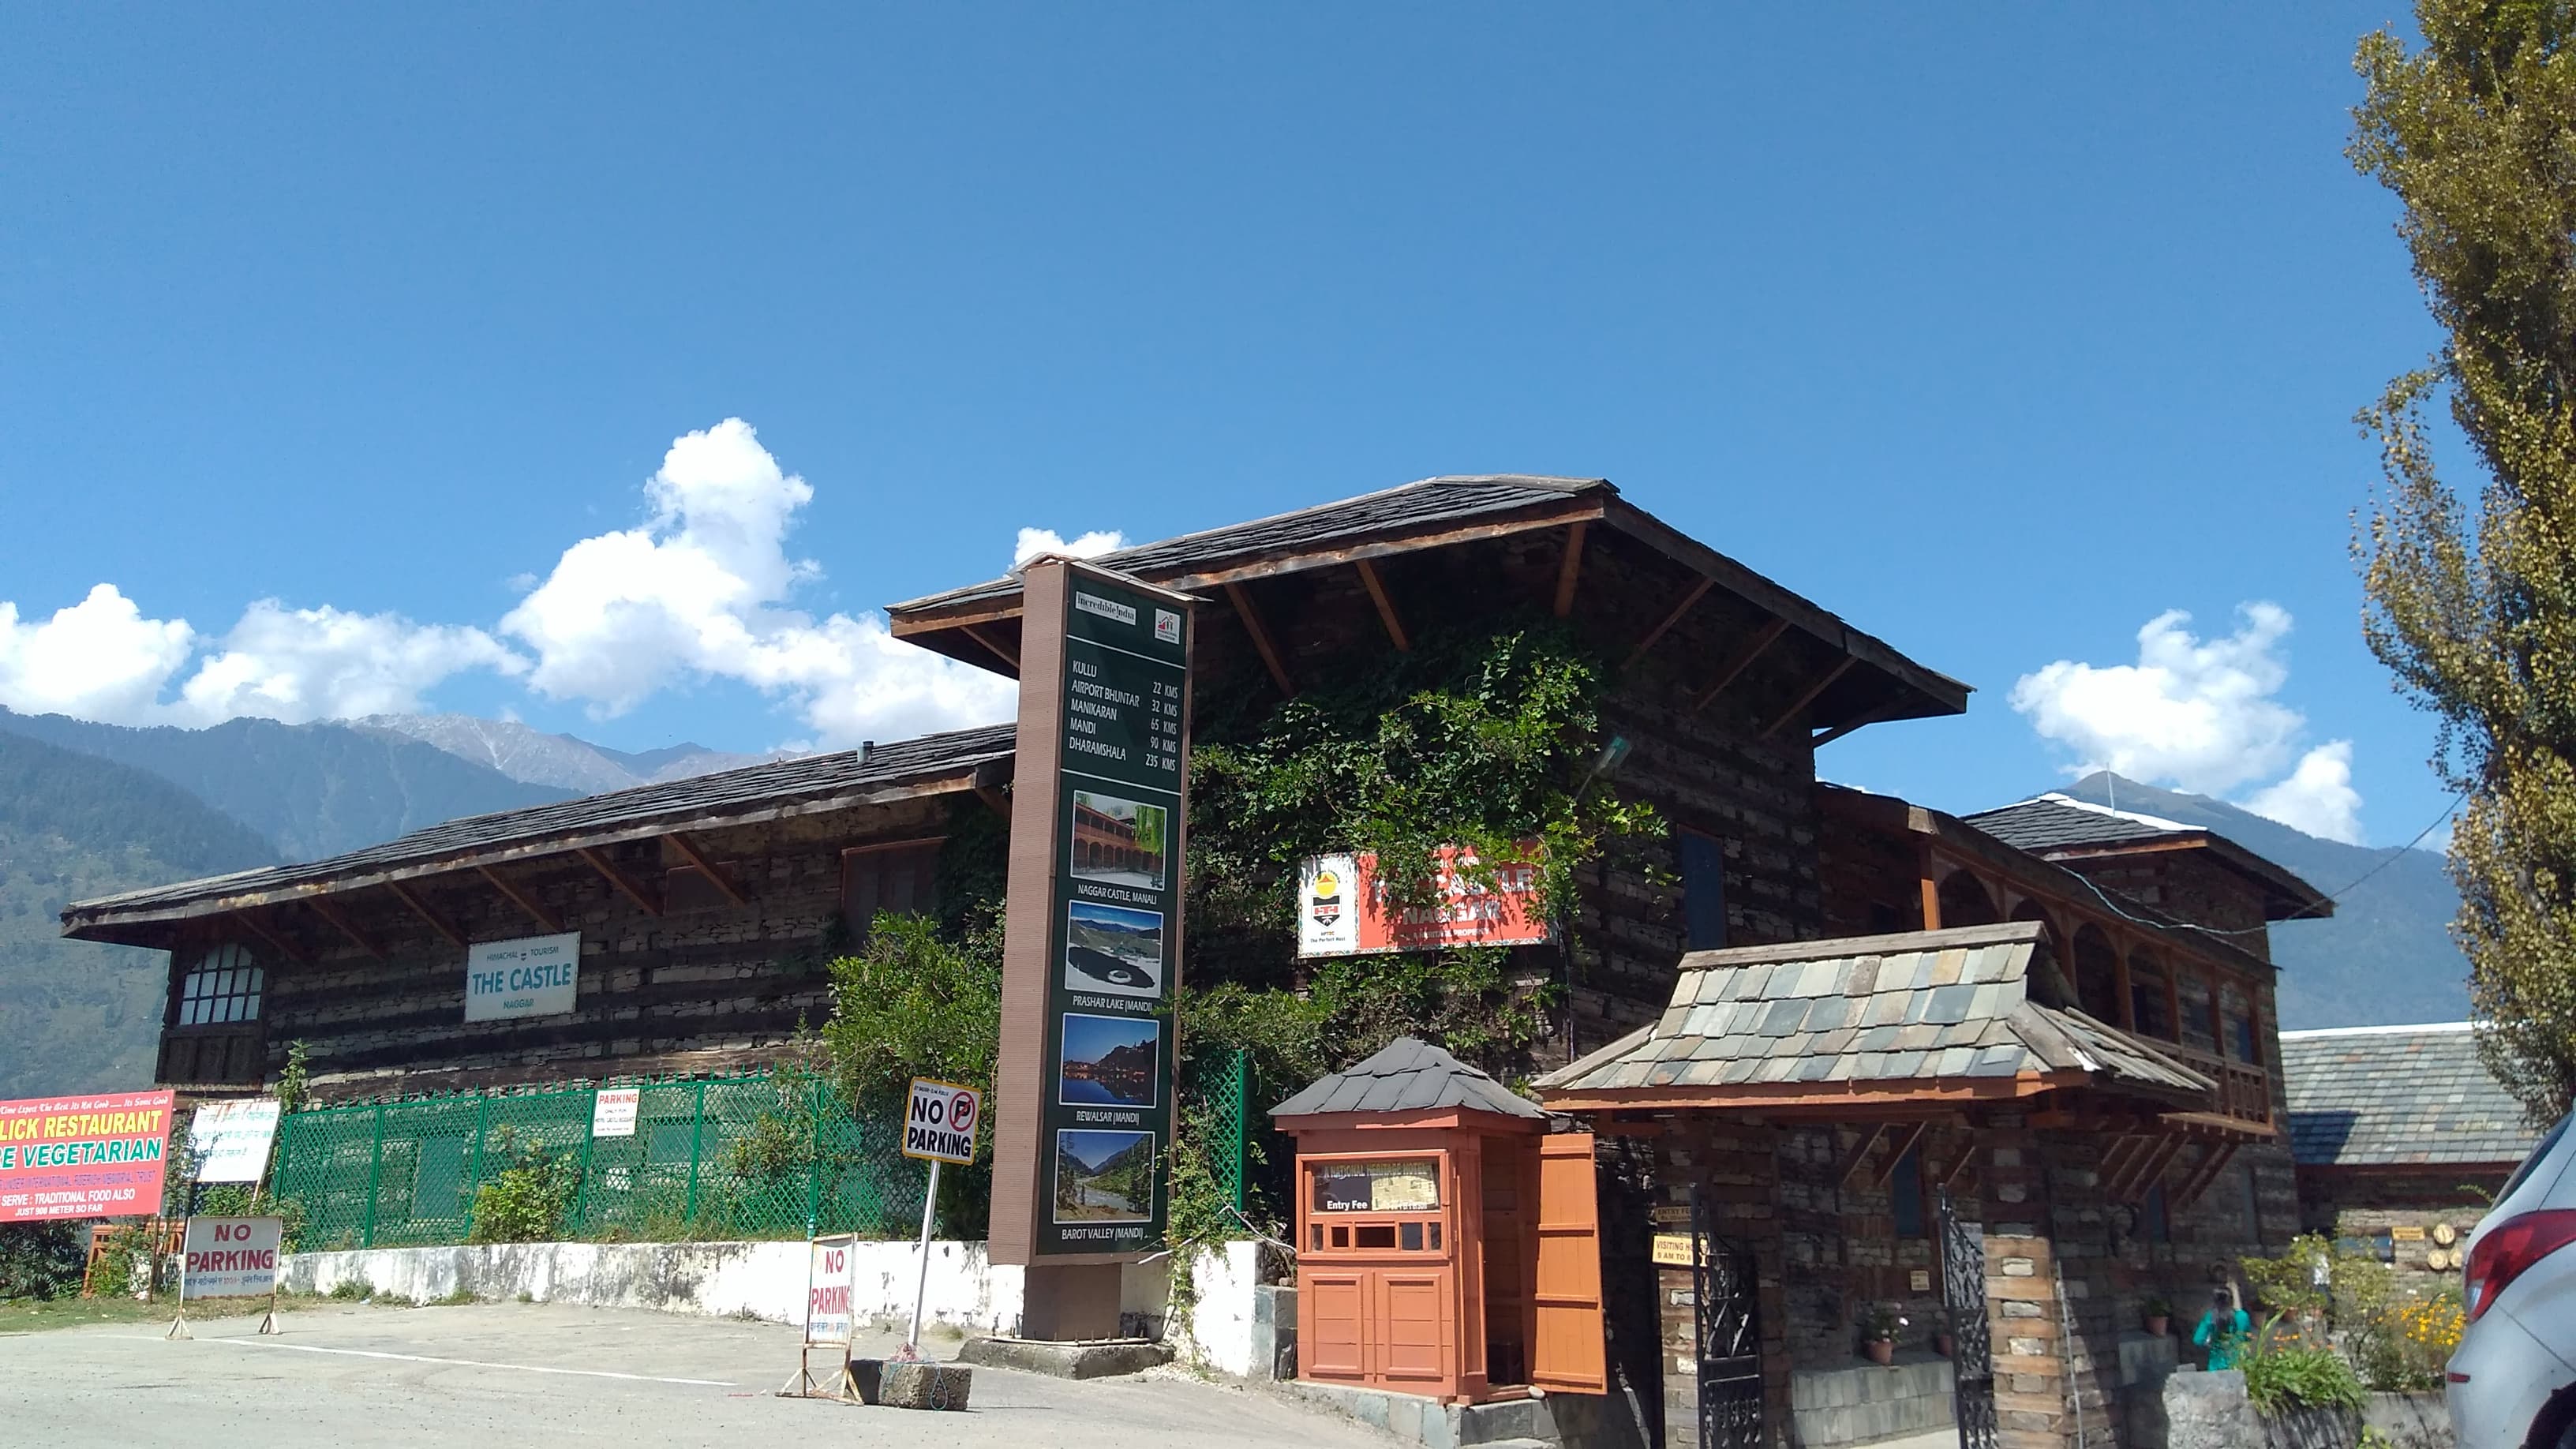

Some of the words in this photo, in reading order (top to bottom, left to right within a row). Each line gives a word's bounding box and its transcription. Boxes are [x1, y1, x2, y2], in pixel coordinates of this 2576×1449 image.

[1073, 660, 1097, 678] KULLU
[1153, 681, 1162, 695] 22
[1164, 684, 1178, 699] KMS
[1072, 680, 1104, 698] AIRPORT
[1105, 687, 1140, 708] BHUNTAR
[1151, 699, 1160, 713] 32
[1163, 702, 1178, 717] KMS
[1070, 698, 1117, 721] MANIKARAN
[1151, 717, 1159, 731] 65
[1163, 721, 1177, 735] KMS
[1069, 717, 1096, 735] MANDI
[1150, 736, 1159, 750] 90
[1163, 739, 1176, 754] KMS
[1069, 736, 1126, 761] DHARAMSHALA
[1145, 753, 1158, 767] 235
[1162, 757, 1176, 771] KMS
[1077, 884, 1106, 897] NAGGAR
[1107, 888, 1131, 902] CASTLE,
[1132, 892, 1157, 904] MANALI
[1452, 927, 1490, 937] PROPERTY
[487, 950, 519, 962] HIMACHAL
[531, 946, 560, 957] TOURISM
[473, 971, 505, 995] THE
[510, 963, 572, 992] CASTLE
[504, 998, 534, 1010] NAGGAR
[1073, 995, 1106, 1008] PRASHAR
[1106, 998, 1125, 1009] LAKE
[1125, 1000, 1152, 1013] (MANDI)
[599, 1093, 638, 1105] PARKING
[911, 1095, 944, 1125] NO
[1076, 1110, 1113, 1122] REWALSAR
[1113, 1112, 1140, 1126] (MANDI)
[43, 1110, 163, 1139] RESTAURANT
[907, 1126, 972, 1158] PARKING
[0, 1144, 16, 1169] E
[23, 1138, 163, 1169] VEGETARIAN
[2, 1194, 28, 1207] SERVE
[35, 1190, 87, 1205] TRADITIONAL
[88, 1189, 113, 1203] FOOD
[113, 1188, 135, 1200] ALSO
[1327, 1200, 1350, 1211] Entry
[1351, 1200, 1368, 1210] Fee
[15, 1206, 34, 1217] JUST
[48, 1204, 74, 1215] METER
[75, 1204, 87, 1214] SO
[88, 1204, 103, 1213] FAR
[215, 1224, 252, 1242] NO
[1062, 1228, 1087, 1240] BAROT
[1088, 1228, 1114, 1239] VALLEY
[1114, 1227, 1144, 1241] (MANDI)
[1657, 1241, 1684, 1251] VISITING
[185, 1249, 274, 1273] PARKING
[826, 1249, 844, 1275] NO
